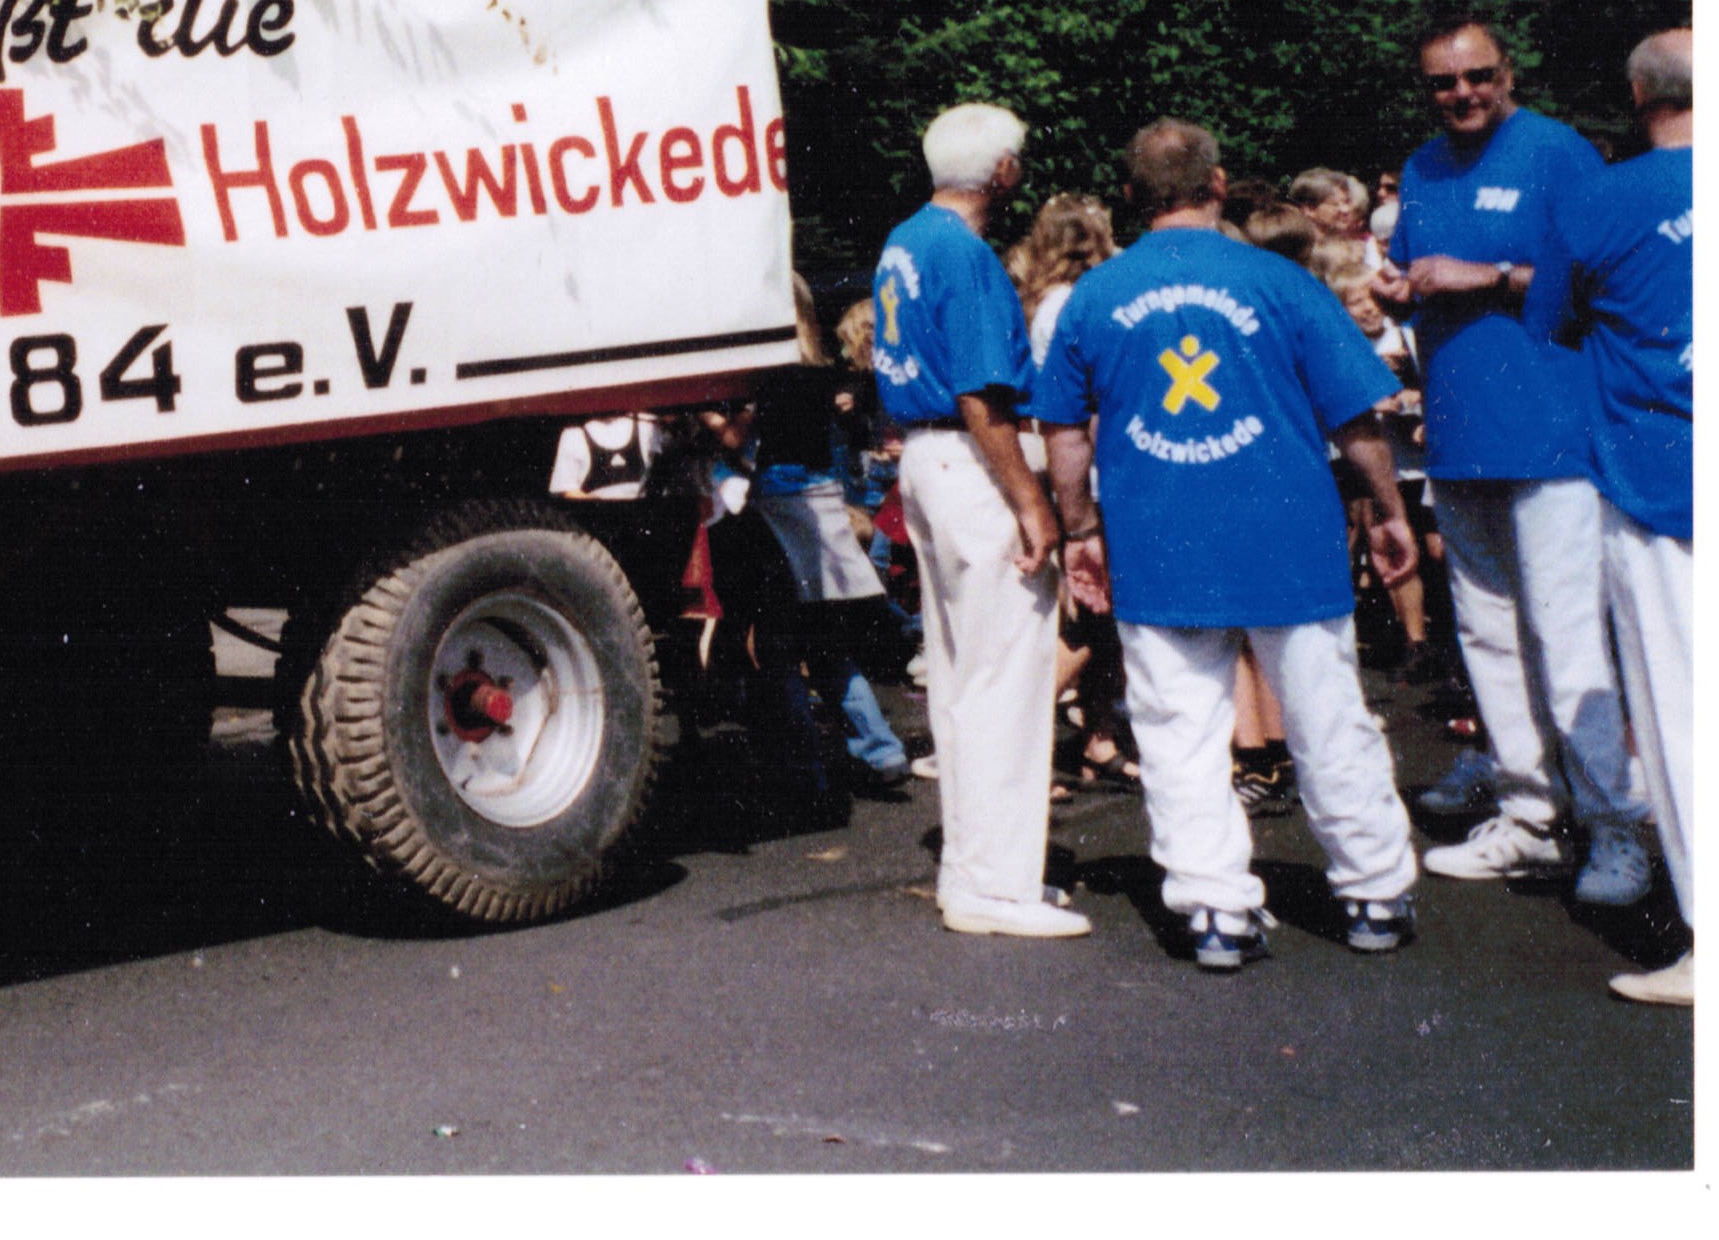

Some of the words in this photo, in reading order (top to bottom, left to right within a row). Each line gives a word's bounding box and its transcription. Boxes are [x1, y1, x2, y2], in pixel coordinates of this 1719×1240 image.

[1112, 284, 1260, 336] Turngemeinde
[234, 301, 428, 406] e.V.
[1125, 414, 1265, 464] Holzwickede
